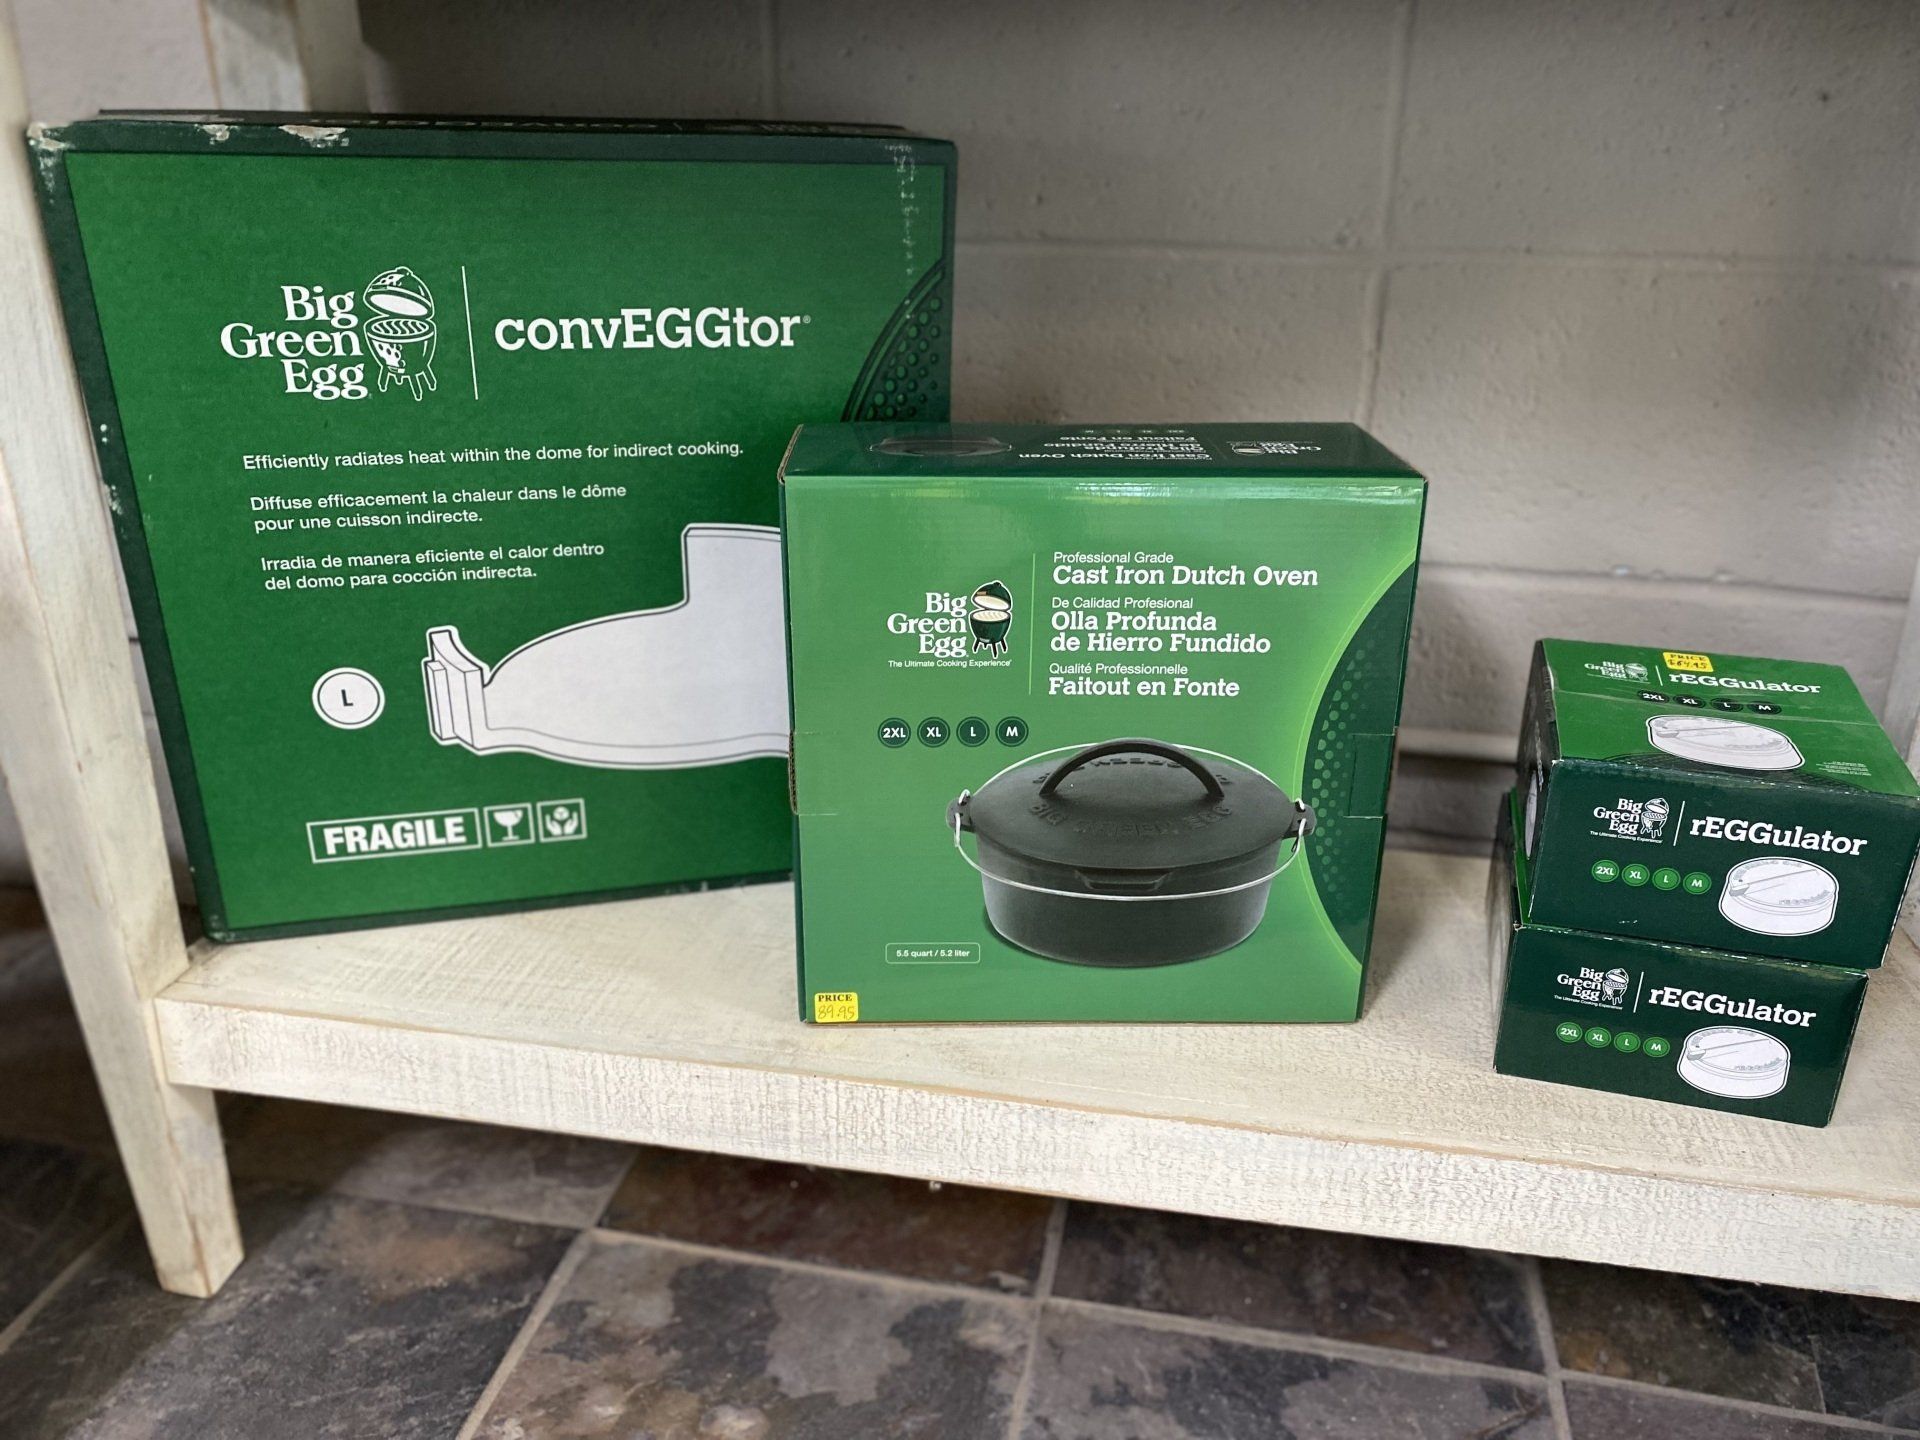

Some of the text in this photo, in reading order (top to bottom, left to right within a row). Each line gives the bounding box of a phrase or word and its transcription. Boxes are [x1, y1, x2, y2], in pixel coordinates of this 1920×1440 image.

[280, 286, 358, 328] Big
[220, 323, 364, 358] Green
[280, 359, 368, 400] Egg
[243, 442, 744, 470] Efficiently radiates heat within the dome for indirect cooking.
[250, 484, 627, 511] Diffuse efficacement la chaleur dans le dôme
[254, 509, 482, 534] pour une cuisson indirecte.
[261, 543, 604, 571] Irradia de manera eficiente el calor dentro
[1054, 552, 1174, 563] Professional Grade
[264, 564, 536, 590] del domo para cocción indirecta.
[1053, 565, 1318, 586] Cast Iron Dutch Oven
[926, 592, 967, 618] Big
[1052, 597, 1193, 609] De Calidad Profesional
[887, 613, 967, 634] Green
[1051, 611, 1217, 631] Olla Profunda
[919, 634, 968, 658] Egg
[1050, 632, 1271, 653] de Hierro Fundido
[888, 660, 902, 668] The
[937, 660, 967, 668] Cooking
[1049, 662, 1188, 675] Qualité Professionnelle
[1049, 677, 1240, 696] Faitout en Fonte
[1669, 674, 1821, 693] rEGGulator
[341, 690, 354, 706] L
[1642, 692, 1664, 701] 2XL
[882, 726, 1018, 738] 2XL XL L M
[1593, 807, 1640, 822] Green
[1617, 798, 1643, 814] Big
[323, 816, 466, 855] FRAGILE
[1609, 820, 1639, 835] Egg
[1690, 816, 1868, 856] rEGGulator
[1596, 866, 1702, 887] 2XL XL L M
[911, 950, 933, 958] quart
[1557, 974, 1601, 990] Green
[1580, 967, 1604, 982] Big
[818, 994, 852, 1002] PRICE
[1572, 986, 1600, 1001] Egg
[818, 1004, 854, 1020] 89.95
[1648, 986, 1816, 1027] rEGGulator
[1560, 1028, 1578, 1037] 2XL
